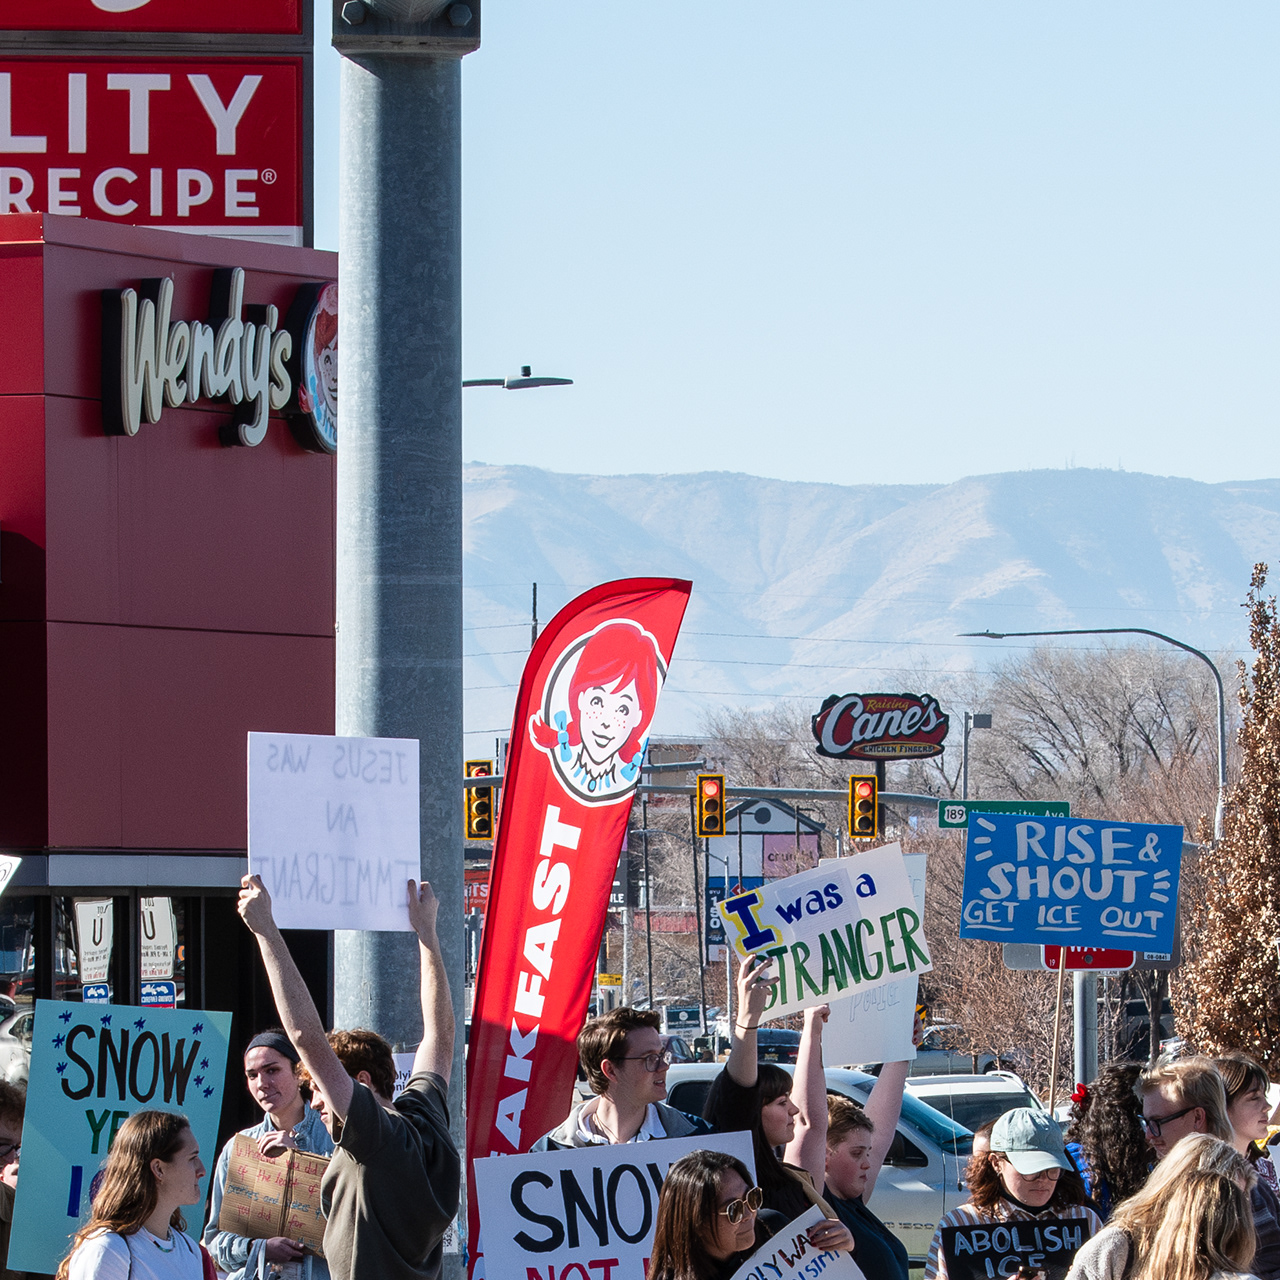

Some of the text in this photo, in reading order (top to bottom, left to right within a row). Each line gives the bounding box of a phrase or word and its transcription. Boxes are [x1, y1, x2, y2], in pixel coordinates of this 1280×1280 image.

[120, 266, 294, 447] Wendy's
[821, 695, 945, 754] Cane's
[866, 699, 910, 711] Raising
[899, 745, 934, 753] FINGERS
[946, 809, 964, 820] 189
[1016, 821, 1162, 866] RISE &
[979, 862, 1149, 904] SHOUT
[724, 892, 777, 952] I
[774, 881, 845, 926] was
[855, 872, 878, 898] a
[963, 899, 1165, 932] GET ICE OUT
[750, 907, 931, 1012] STRANGER
[61, 1024, 201, 1106] SNOW
[256, 1169, 272, 1183] the
[898, 1222, 935, 1230] 1500
[954, 1225, 1083, 1257] ABOLISH
[778, 1228, 814, 1269] WA
